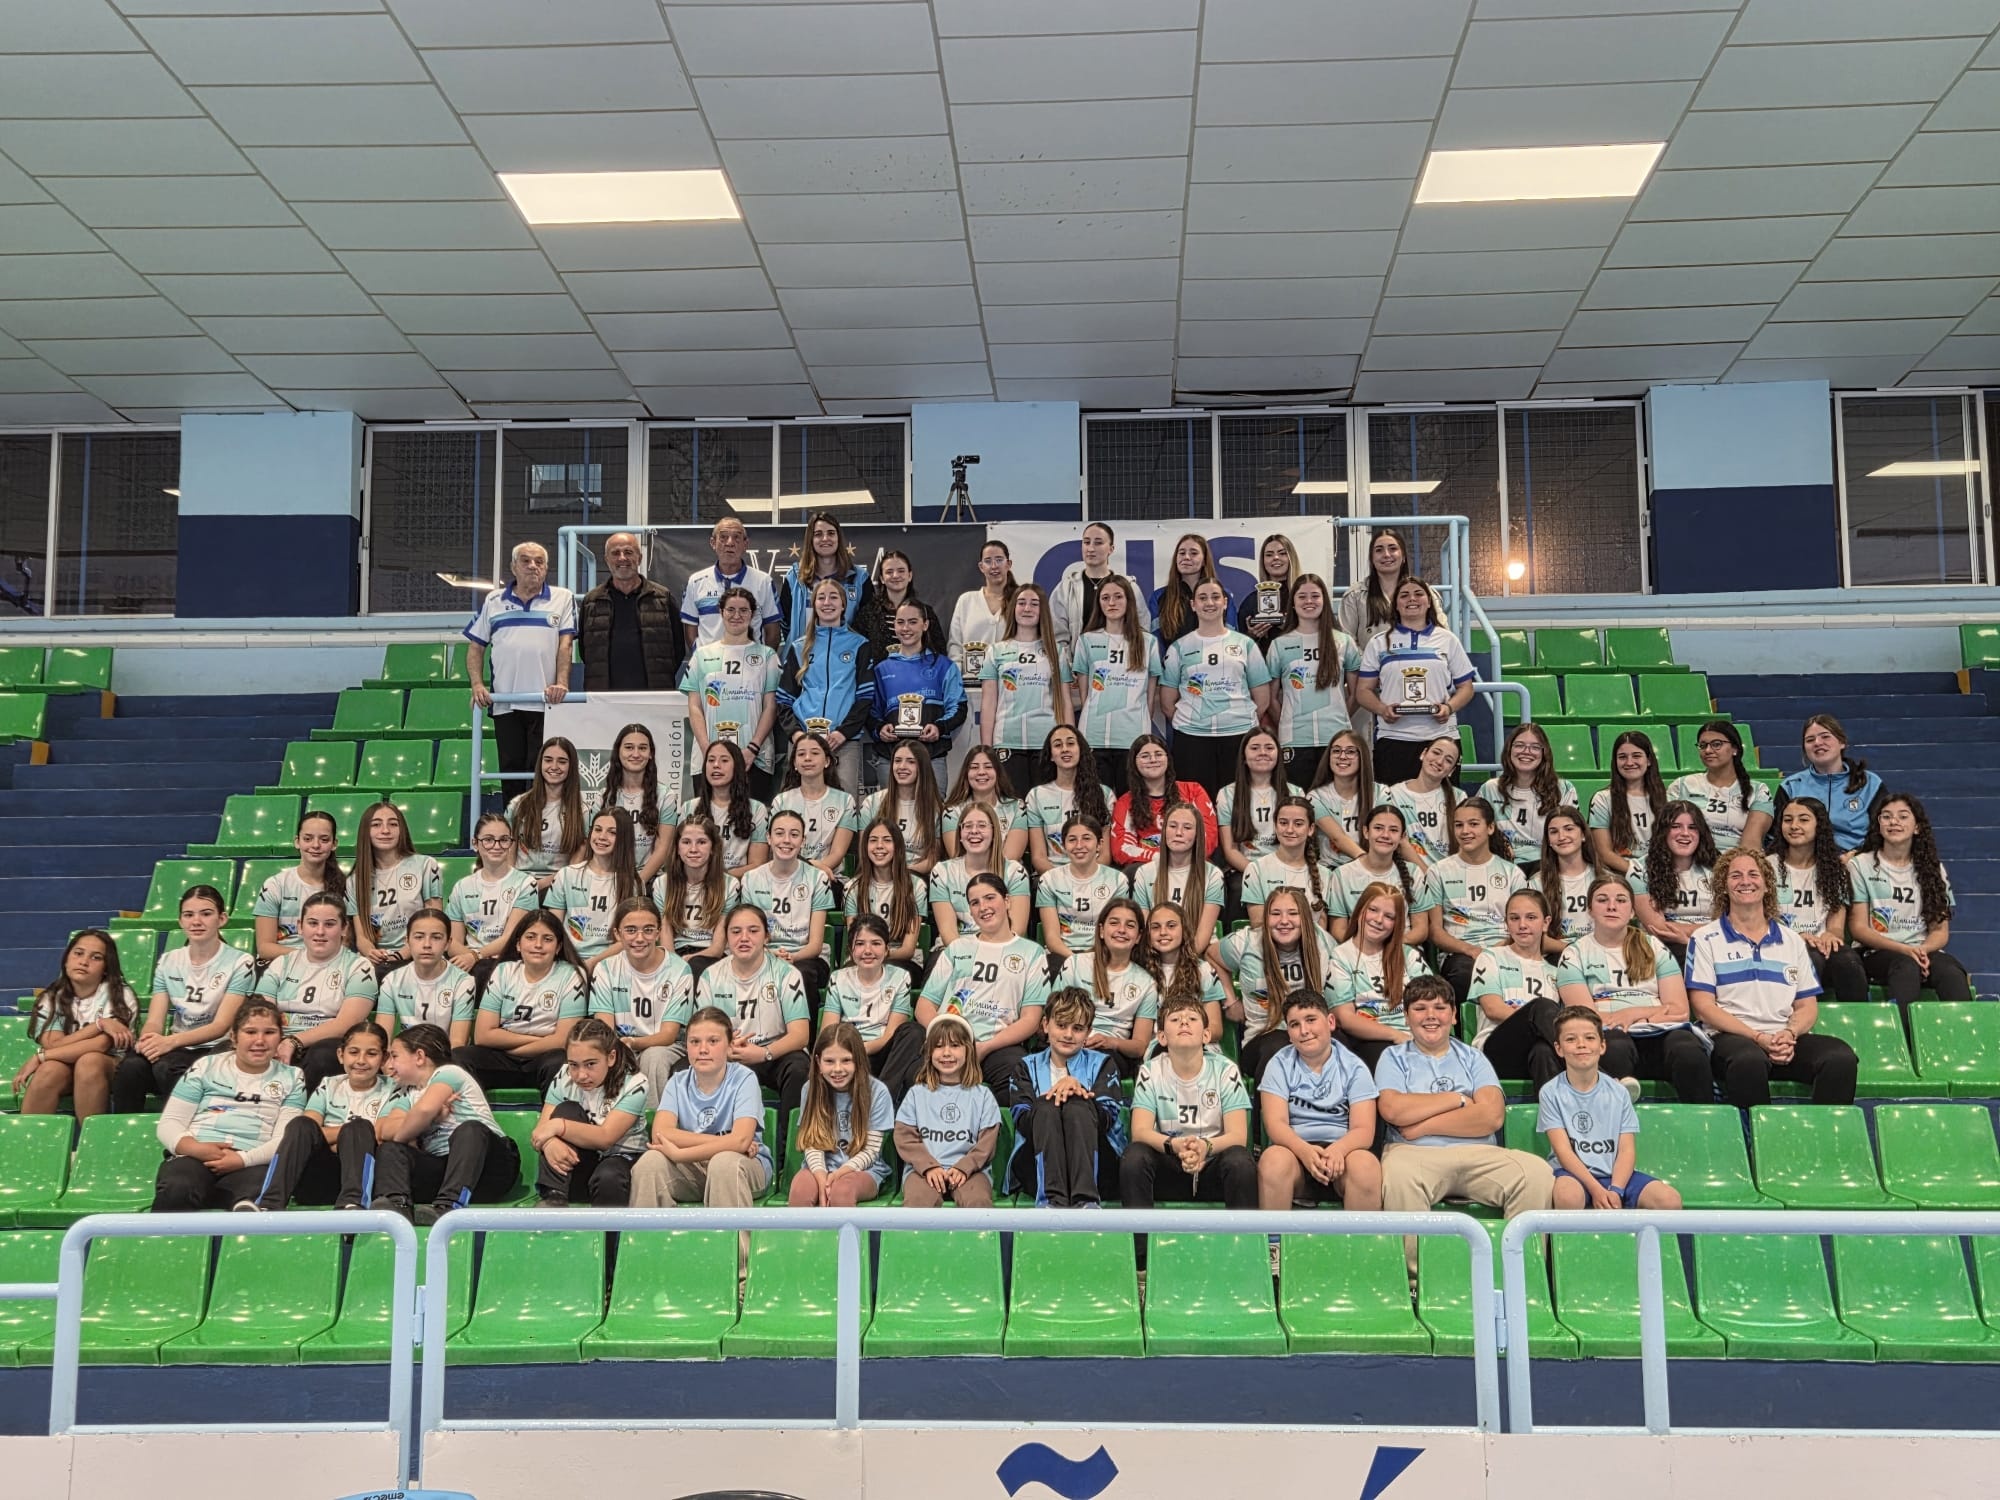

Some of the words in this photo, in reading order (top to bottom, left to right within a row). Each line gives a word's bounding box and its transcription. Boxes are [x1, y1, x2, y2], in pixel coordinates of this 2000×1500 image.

[1018, 652, 1037, 664] 62
[1109, 650, 1124, 664] 31
[1208, 653, 1219, 666] 8
[1304, 649, 1320, 662] 30
[725, 660, 741, 675] 12
[668, 719, 682, 796] ndación
[1255, 807, 1270, 823] 17
[1707, 799, 1727, 814] 33
[809, 818, 817, 832] 2
[1418, 811, 1438, 828] 88
[1516, 808, 1527, 826] 4
[1633, 813, 1647, 828] 11
[378, 888, 397, 907] 22
[1172, 887, 1181, 903] 4
[1468, 885, 1486, 901] 19
[1679, 890, 1697, 907] 47
[1794, 889, 1814, 908] 24
[1892, 887, 1914, 904] 42
[482, 899, 497, 916] 17
[591, 895, 608, 913] 14
[773, 897, 791, 914] 26
[880, 902, 889, 919] 9
[1075, 897, 1090, 912] 13
[1567, 895, 1587, 913] 29
[686, 905, 703, 921] 72
[972, 961, 999, 983] 20
[1281, 963, 1303, 981] 10
[1371, 975, 1385, 994] 3
[1525, 976, 1543, 997] 12
[185, 986, 205, 1003] 25
[303, 986, 316, 1004] 8
[421, 1003, 429, 1020] 7
[514, 1004, 533, 1022] 52
[632, 996, 652, 1018] 10
[738, 1000, 757, 1020] 77
[234, 1091, 261, 1105] 64
[1178, 1104, 1199, 1125] 37
